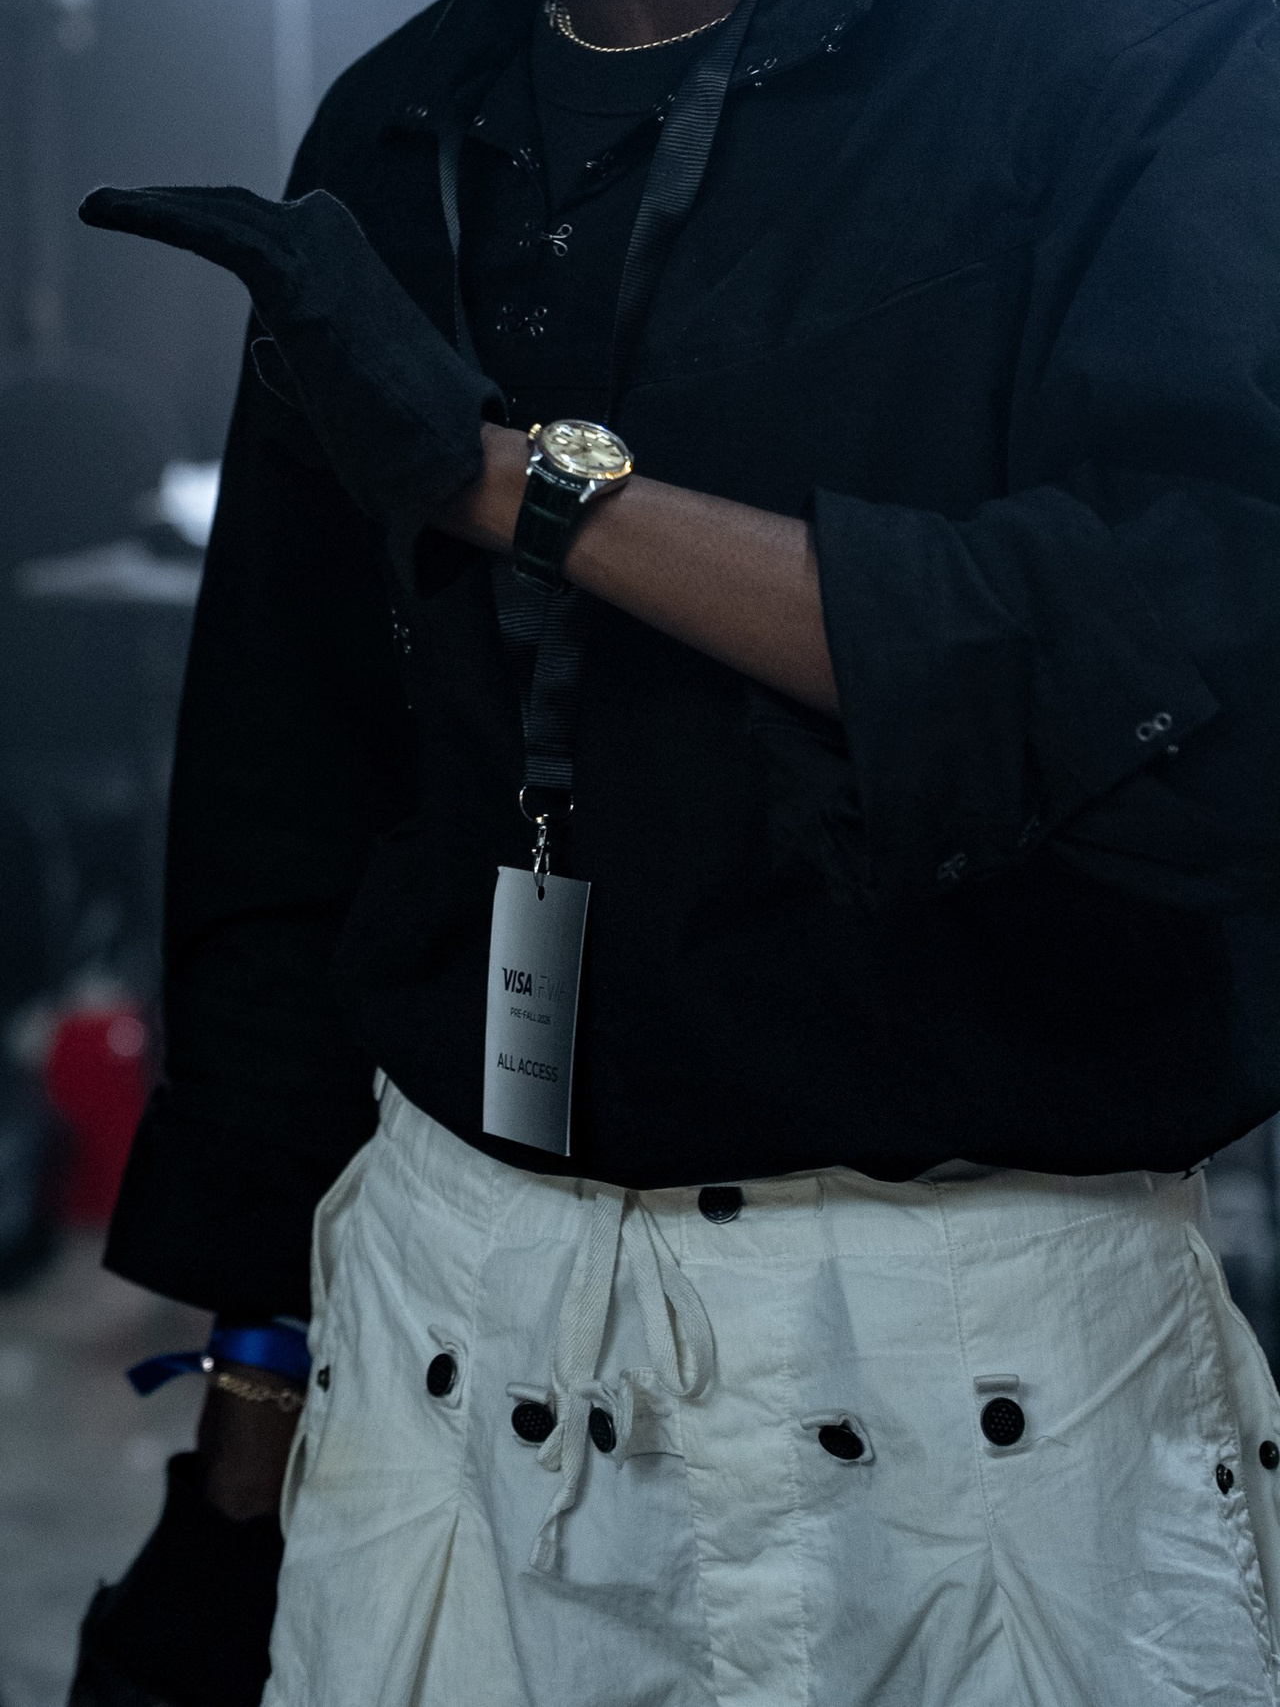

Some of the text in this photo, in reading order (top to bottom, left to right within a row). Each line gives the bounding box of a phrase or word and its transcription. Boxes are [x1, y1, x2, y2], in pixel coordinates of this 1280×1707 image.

[502, 967, 532, 996] VISA
[510, 1007, 537, 1022] PRE-FALL
[497, 1052, 559, 1083] ALL ACCESS
